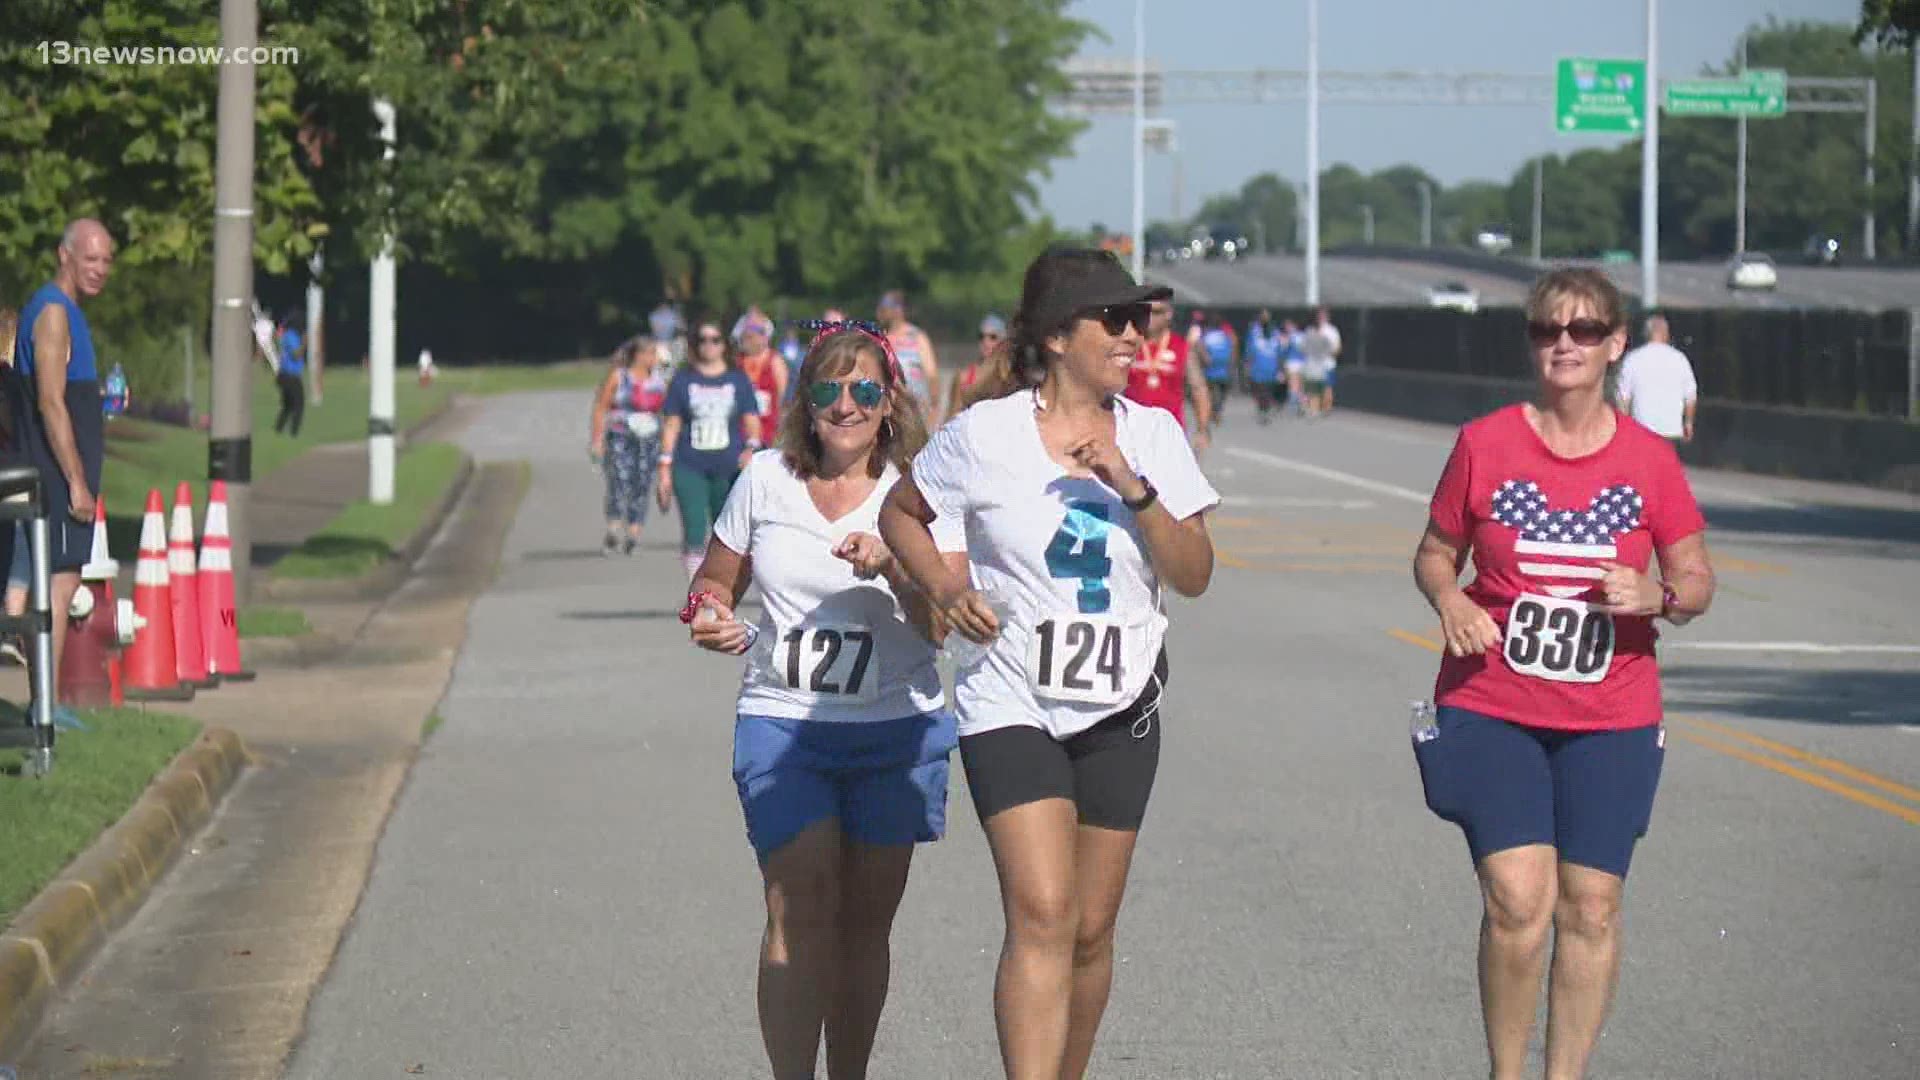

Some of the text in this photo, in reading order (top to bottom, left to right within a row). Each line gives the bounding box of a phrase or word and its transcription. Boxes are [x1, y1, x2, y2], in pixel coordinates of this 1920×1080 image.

[1044, 502, 1112, 614] 4
[784, 630, 873, 694] 127
[1036, 619, 1125, 692] 124
[1509, 601, 1611, 674] 330
